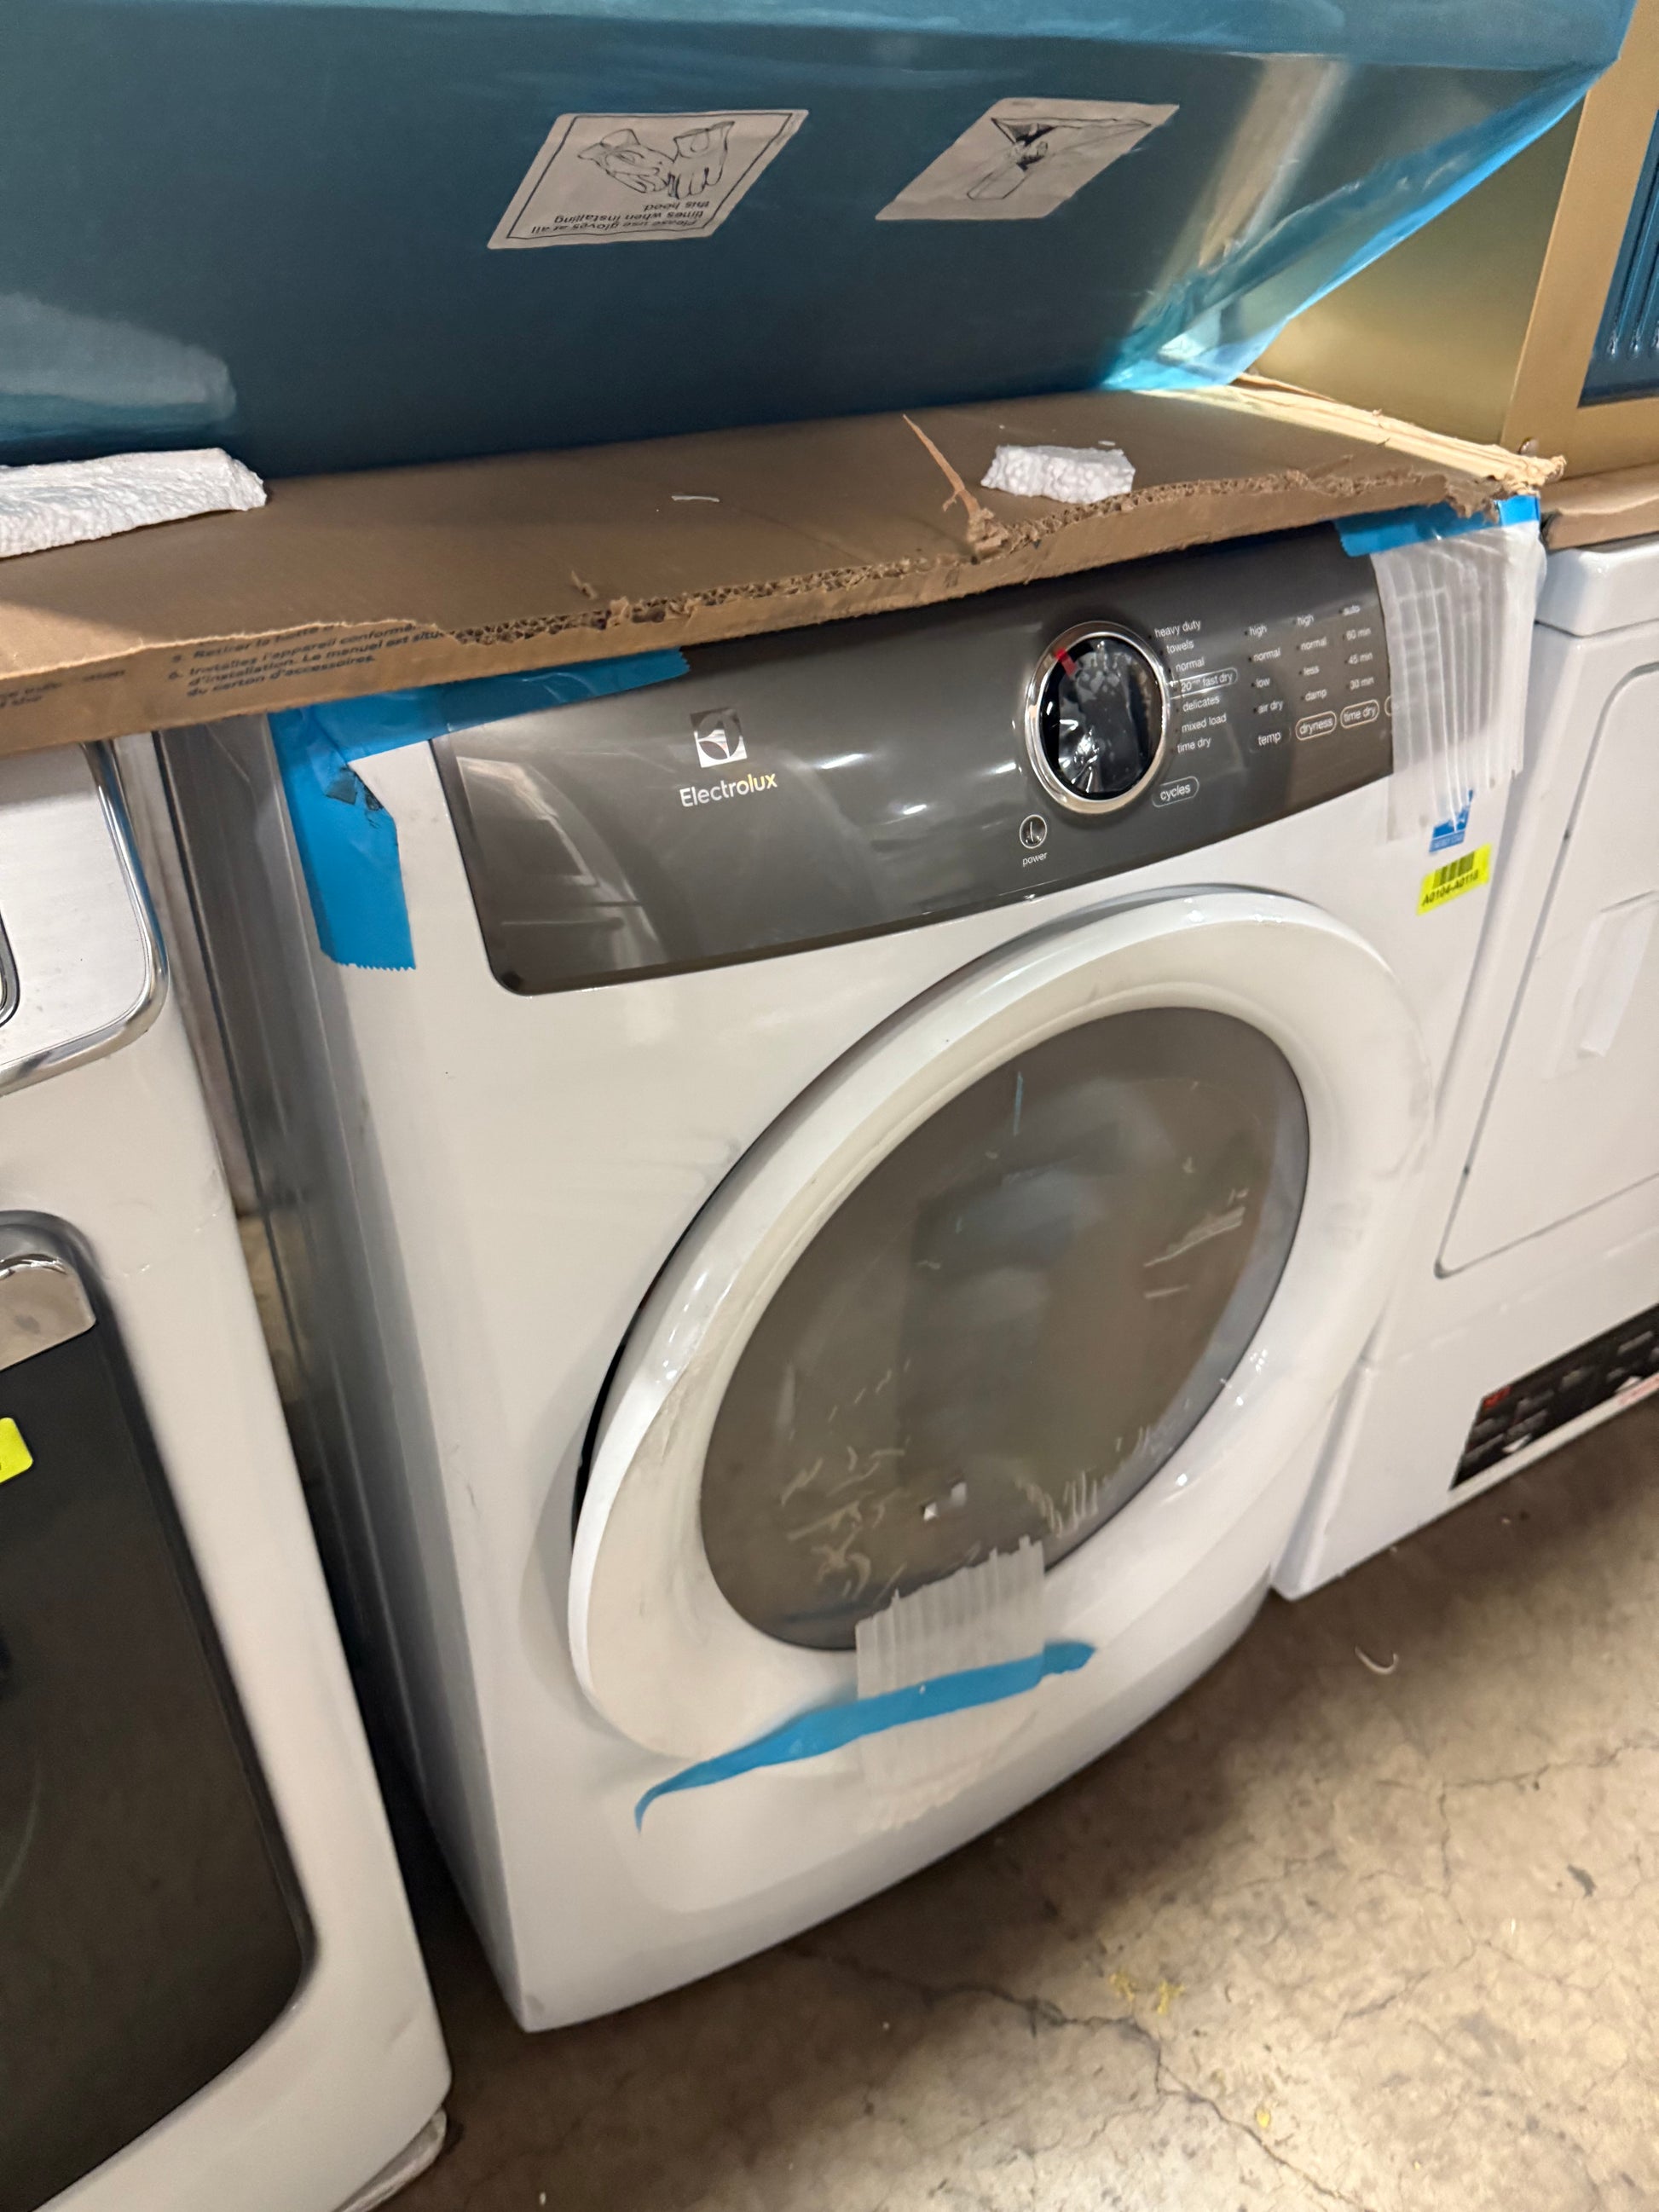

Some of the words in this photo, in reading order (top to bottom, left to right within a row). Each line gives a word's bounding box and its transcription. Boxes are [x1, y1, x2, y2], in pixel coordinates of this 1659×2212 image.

[554, 214, 621, 223] installing
[625, 212, 662, 221] when
[667, 210, 704, 218] times
[573, 222, 620, 230] gloves
[1297, 615, 1314, 627] high
[1154, 624, 1181, 638] heavy
[1182, 621, 1200, 633] duty
[1250, 625, 1268, 638] high
[326, 640, 384, 660] manuel
[1167, 641, 1194, 654] towels
[1301, 638, 1327, 650] normal
[1252, 648, 1280, 662] normal
[1175, 657, 1205, 672] normal
[1304, 665, 1320, 676] less
[1202, 675, 1219, 689] fast
[1219, 672, 1234, 685] dry
[1257, 678, 1270, 688] low
[1305, 689, 1327, 702] damp
[1182, 696, 1220, 712] delicates
[1270, 701, 1284, 712] dry
[1362, 707, 1376, 719] dry
[1182, 718, 1206, 733] mixed
[1209, 713, 1227, 726] load
[1299, 719, 1333, 734] dryness
[1177, 740, 1195, 753] time
[1196, 736, 1211, 750] dry
[1258, 731, 1281, 746] temp
[679, 772, 778, 808] Electrolux
[1159, 784, 1191, 801] cycles
[1022, 851, 1049, 868] power
